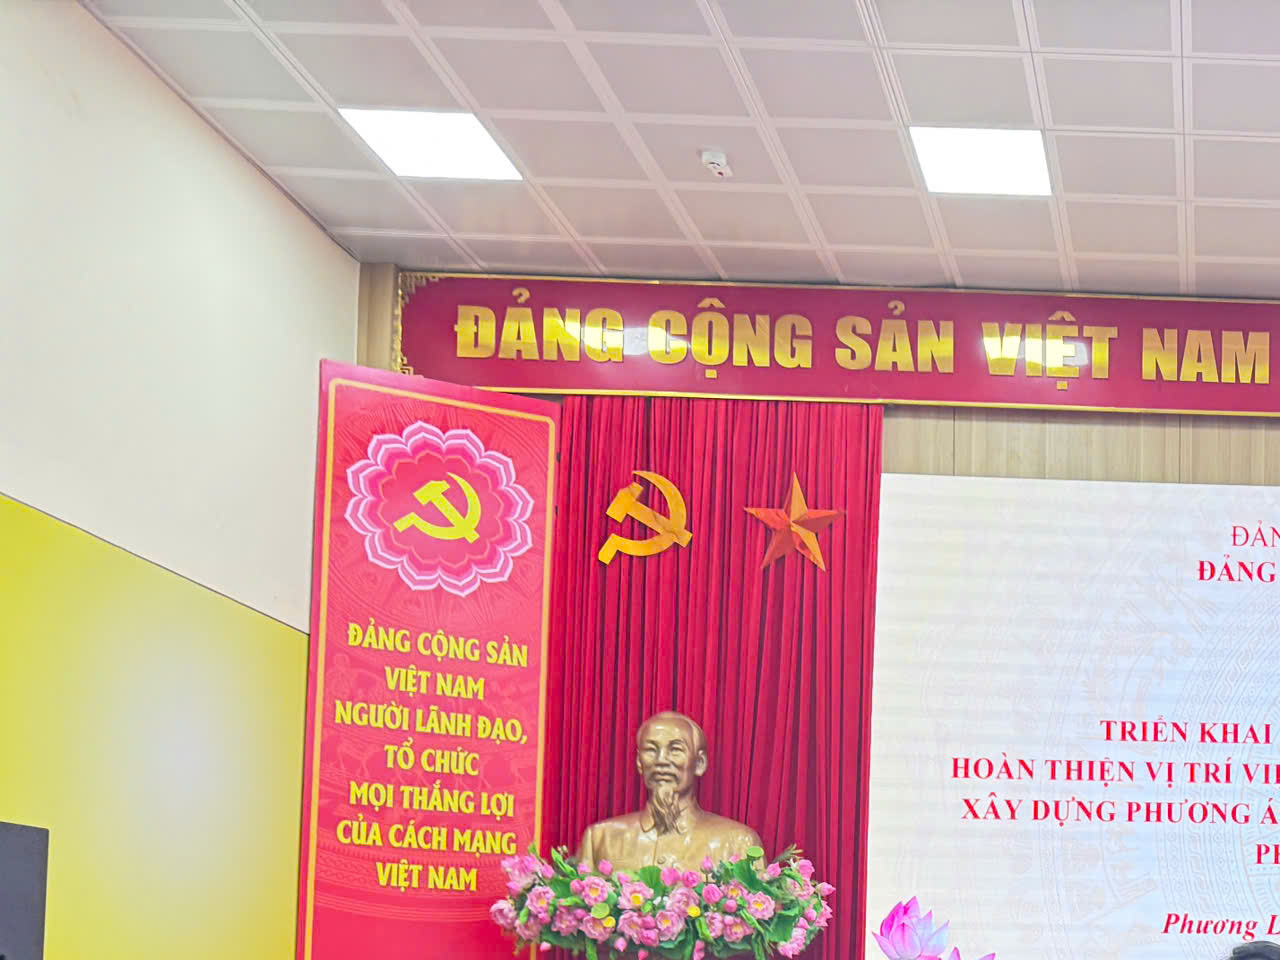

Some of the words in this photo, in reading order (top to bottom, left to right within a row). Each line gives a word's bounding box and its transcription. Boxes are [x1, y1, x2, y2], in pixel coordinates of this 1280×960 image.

[454, 287, 624, 365] ĐẢNG
[649, 297, 812, 379] CỘNG
[835, 300, 955, 373] SẢN
[980, 310, 1118, 390] VIỆT
[1142, 327, 1270, 386] NAM
[1198, 555, 1276, 582] ĐẢNG
[349, 619, 410, 652] ĐẢNG
[418, 632, 480, 661] CỘNG
[486, 635, 528, 667] SẢN
[386, 665, 430, 696] VIỆT
[437, 672, 484, 700] NAM
[336, 701, 409, 730] NGƯỜI
[416, 706, 472, 736] LÃNH
[478, 717, 528, 744] ĐẠO,
[1100, 715, 1188, 744] TRIỂN
[1200, 723, 1270, 744] KHAI
[384, 737, 414, 770] TỔ
[421, 749, 479, 776] CHỨC
[952, 753, 1033, 779] HOÀN
[1046, 760, 1133, 787] THIỆN
[1146, 762, 1173, 788] VỊ
[1184, 758, 1233, 784] TRÍ
[351, 781, 394, 810] MỌI
[400, 781, 474, 813] THẮNG
[481, 792, 514, 820] LỢI
[961, 792, 1022, 820] XÂY
[1034, 797, 1115, 827] DỰNG
[1128, 800, 1250, 824] PHƯƠNG
[337, 816, 382, 846] CỦA
[389, 821, 447, 850] CÁCH
[454, 830, 516, 856] MẠNG
[376, 859, 423, 891] VIỆT
[429, 866, 477, 891] NAM
[1161, 912, 1258, 941] Phương
